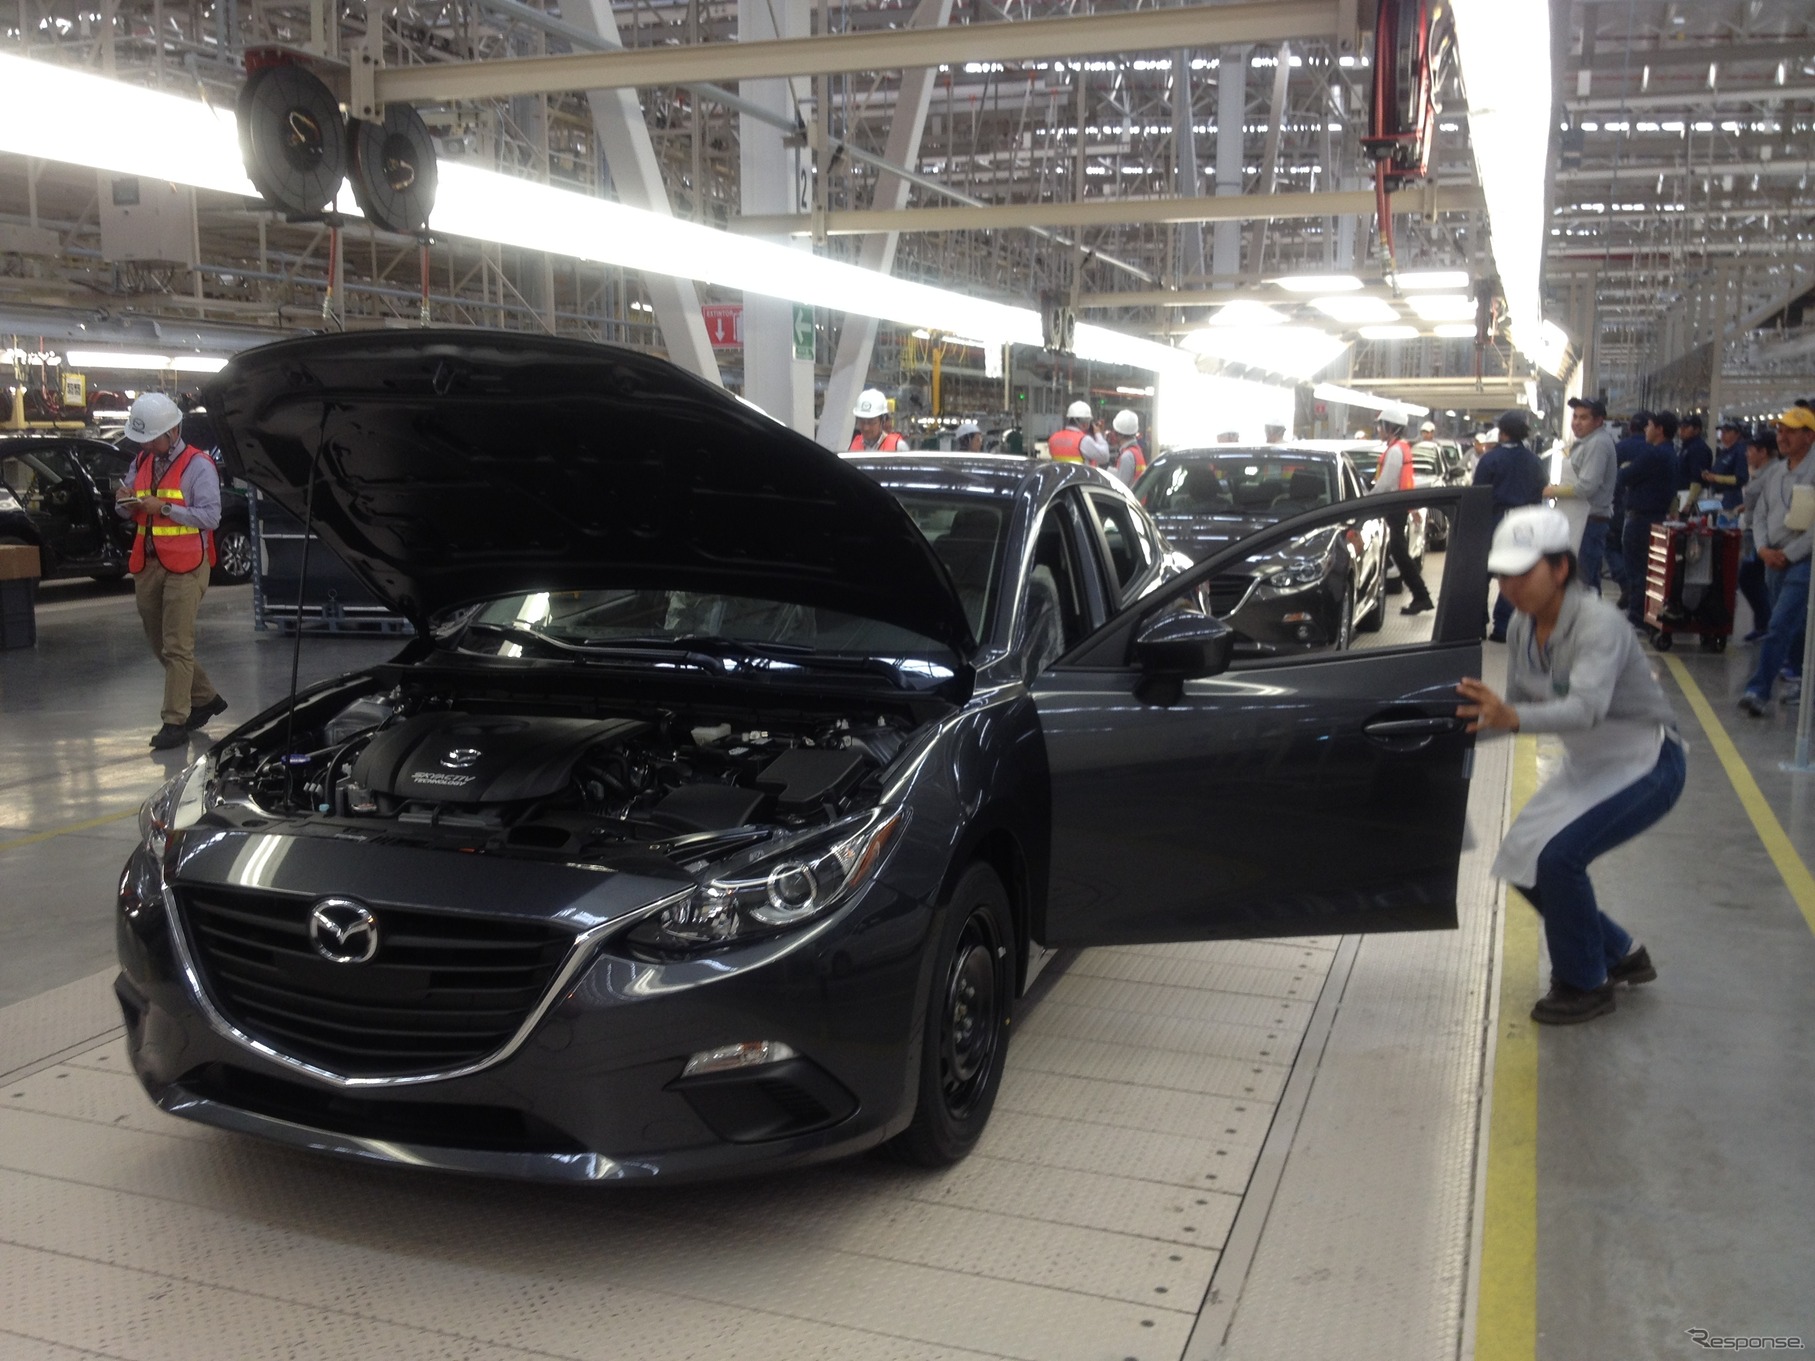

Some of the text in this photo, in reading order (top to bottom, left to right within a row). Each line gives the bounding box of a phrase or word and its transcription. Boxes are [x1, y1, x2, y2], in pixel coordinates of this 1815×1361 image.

[800, 168, 807, 209] 2
[411, 771, 476, 782] SKYACTIV
[414, 778, 467, 786] TECHNOLOGY
